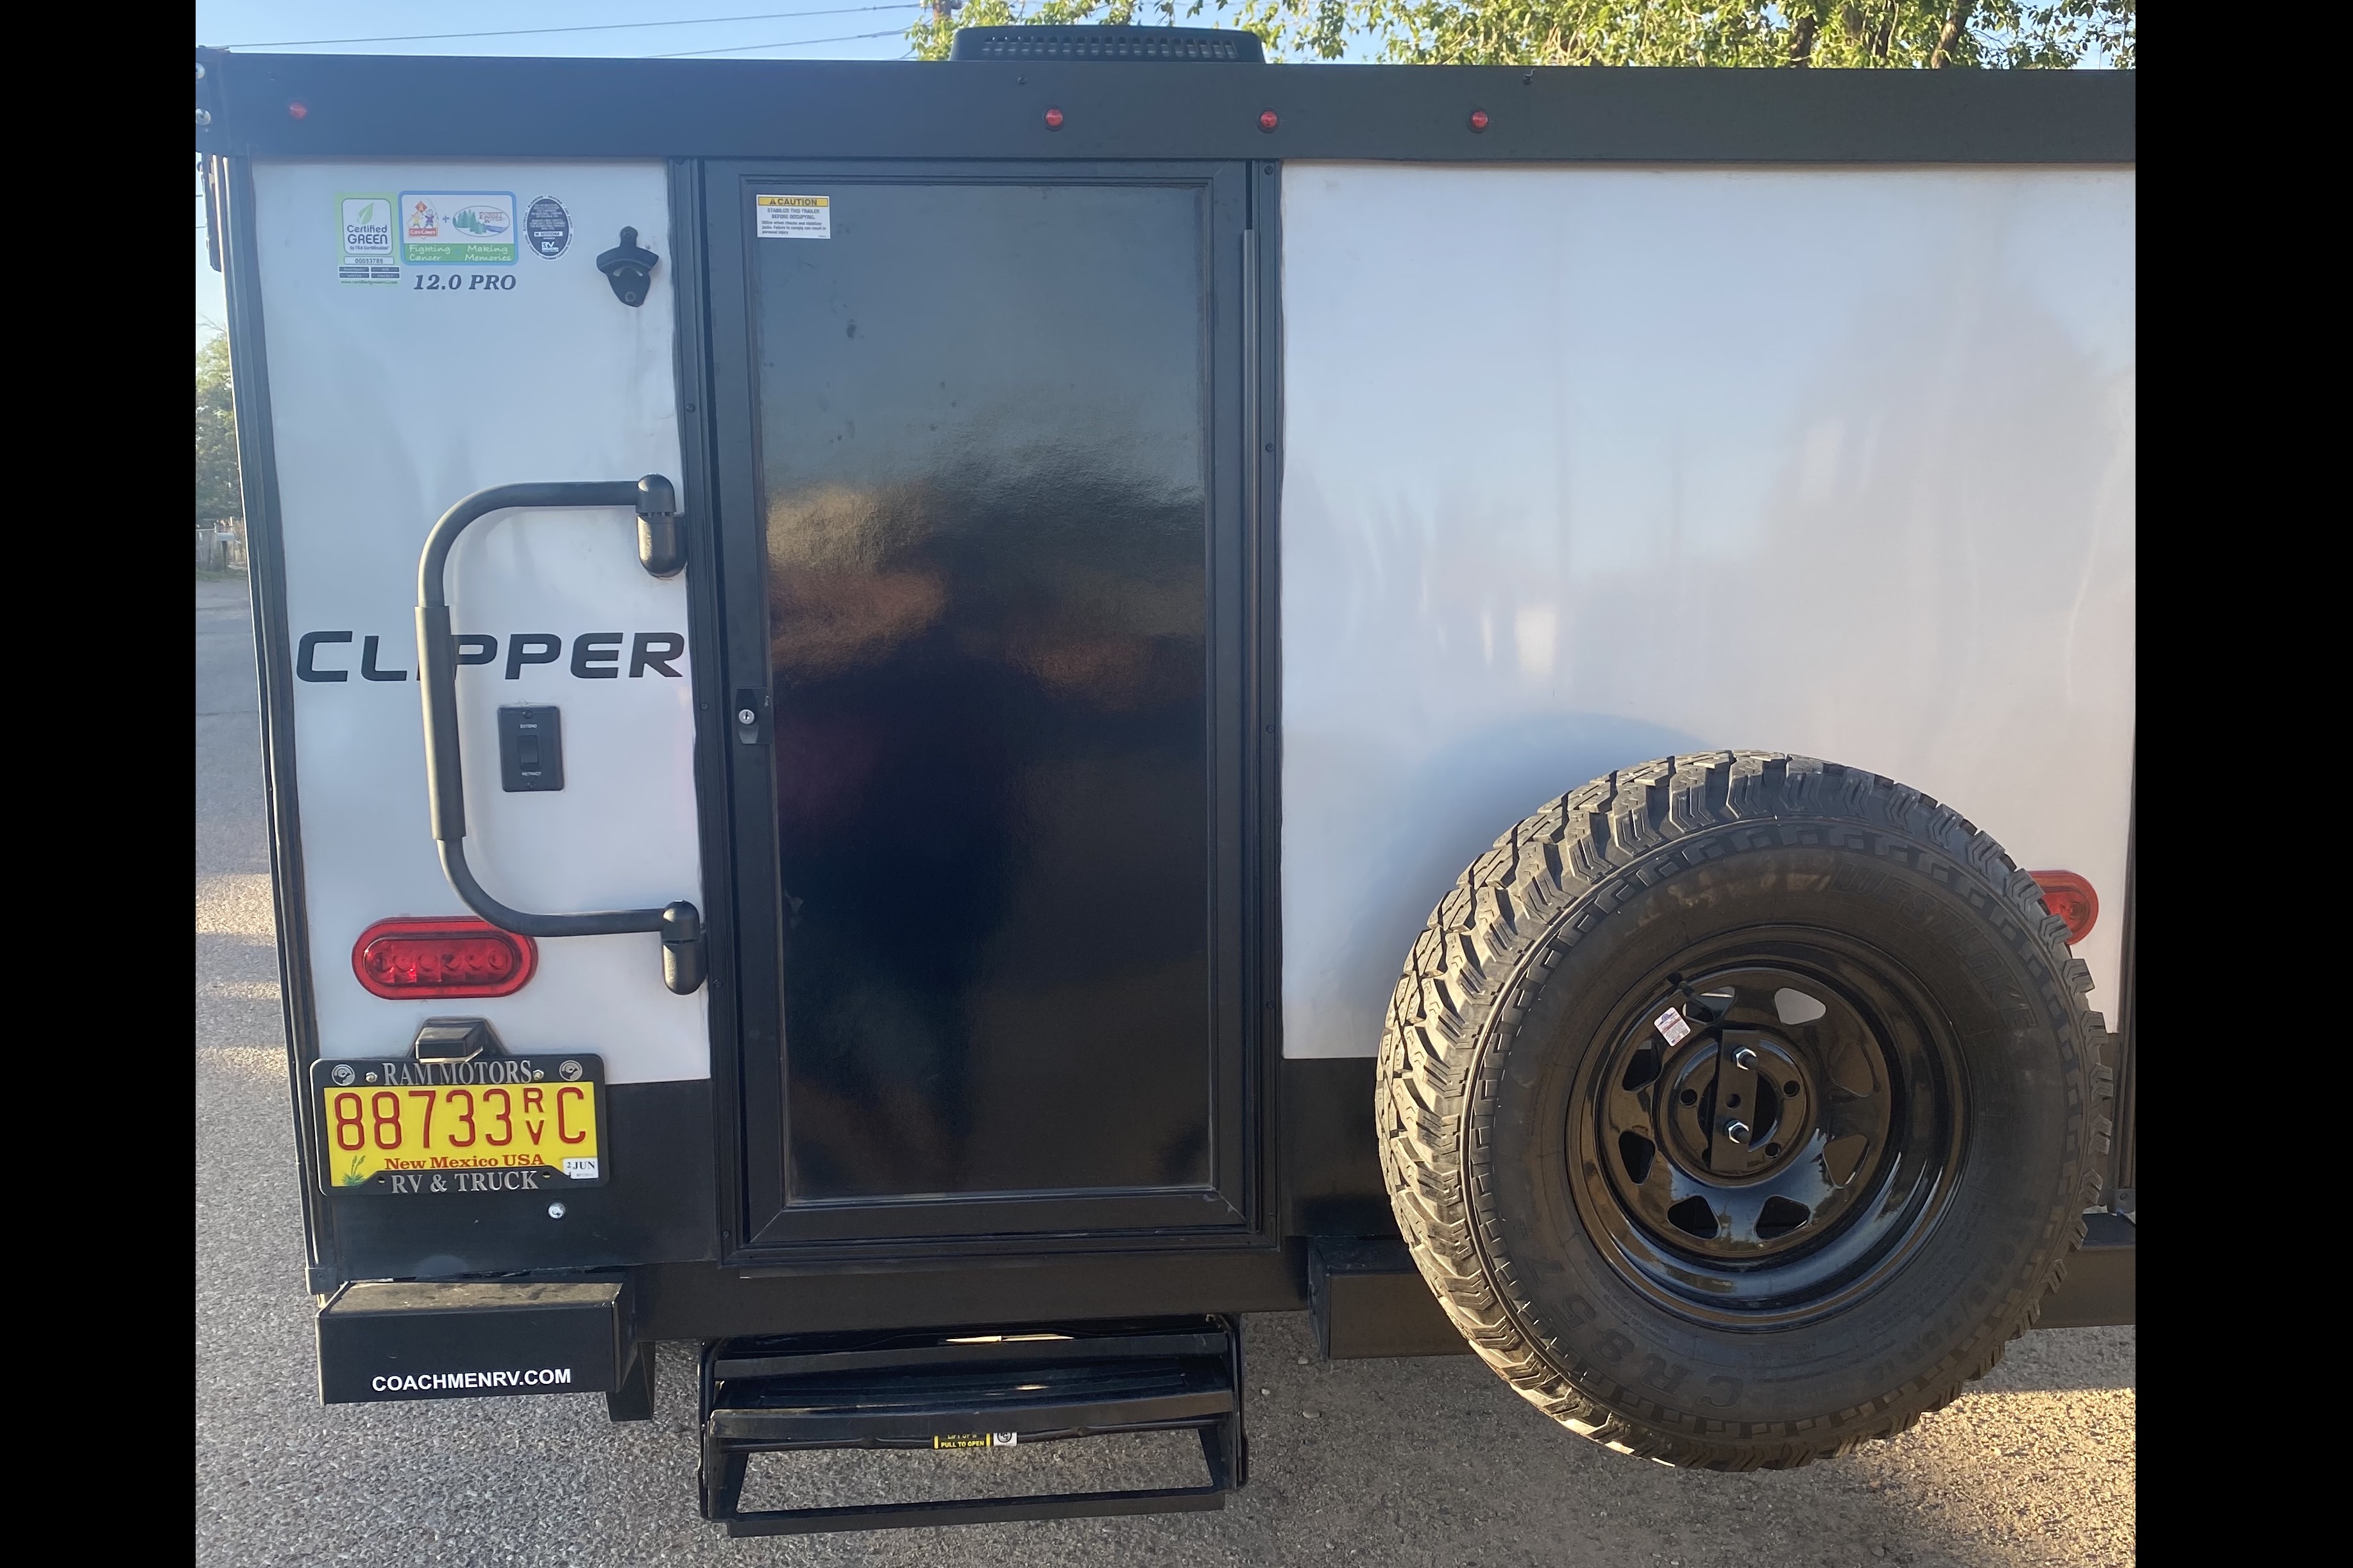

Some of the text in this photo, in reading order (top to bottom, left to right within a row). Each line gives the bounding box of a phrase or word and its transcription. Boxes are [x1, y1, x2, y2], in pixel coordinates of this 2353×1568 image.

[347, 224, 387, 233] Certified
[348, 234, 387, 244] GREEN
[409, 244, 450, 254] Fighting
[467, 244, 508, 253] Making
[413, 274, 516, 290] 12.0 PRO
[296, 630, 685, 682] CLPPER
[1830, 862, 2039, 1028] WESTLAKE
[382, 1060, 532, 1086] RAM MOTORS
[384, 1154, 545, 1170] New Mexico USA
[573, 1161, 595, 1170] JUN
[391, 1170, 539, 1193] RV & TRUCK
[372, 1369, 572, 1392] COACHMENRV.COM
